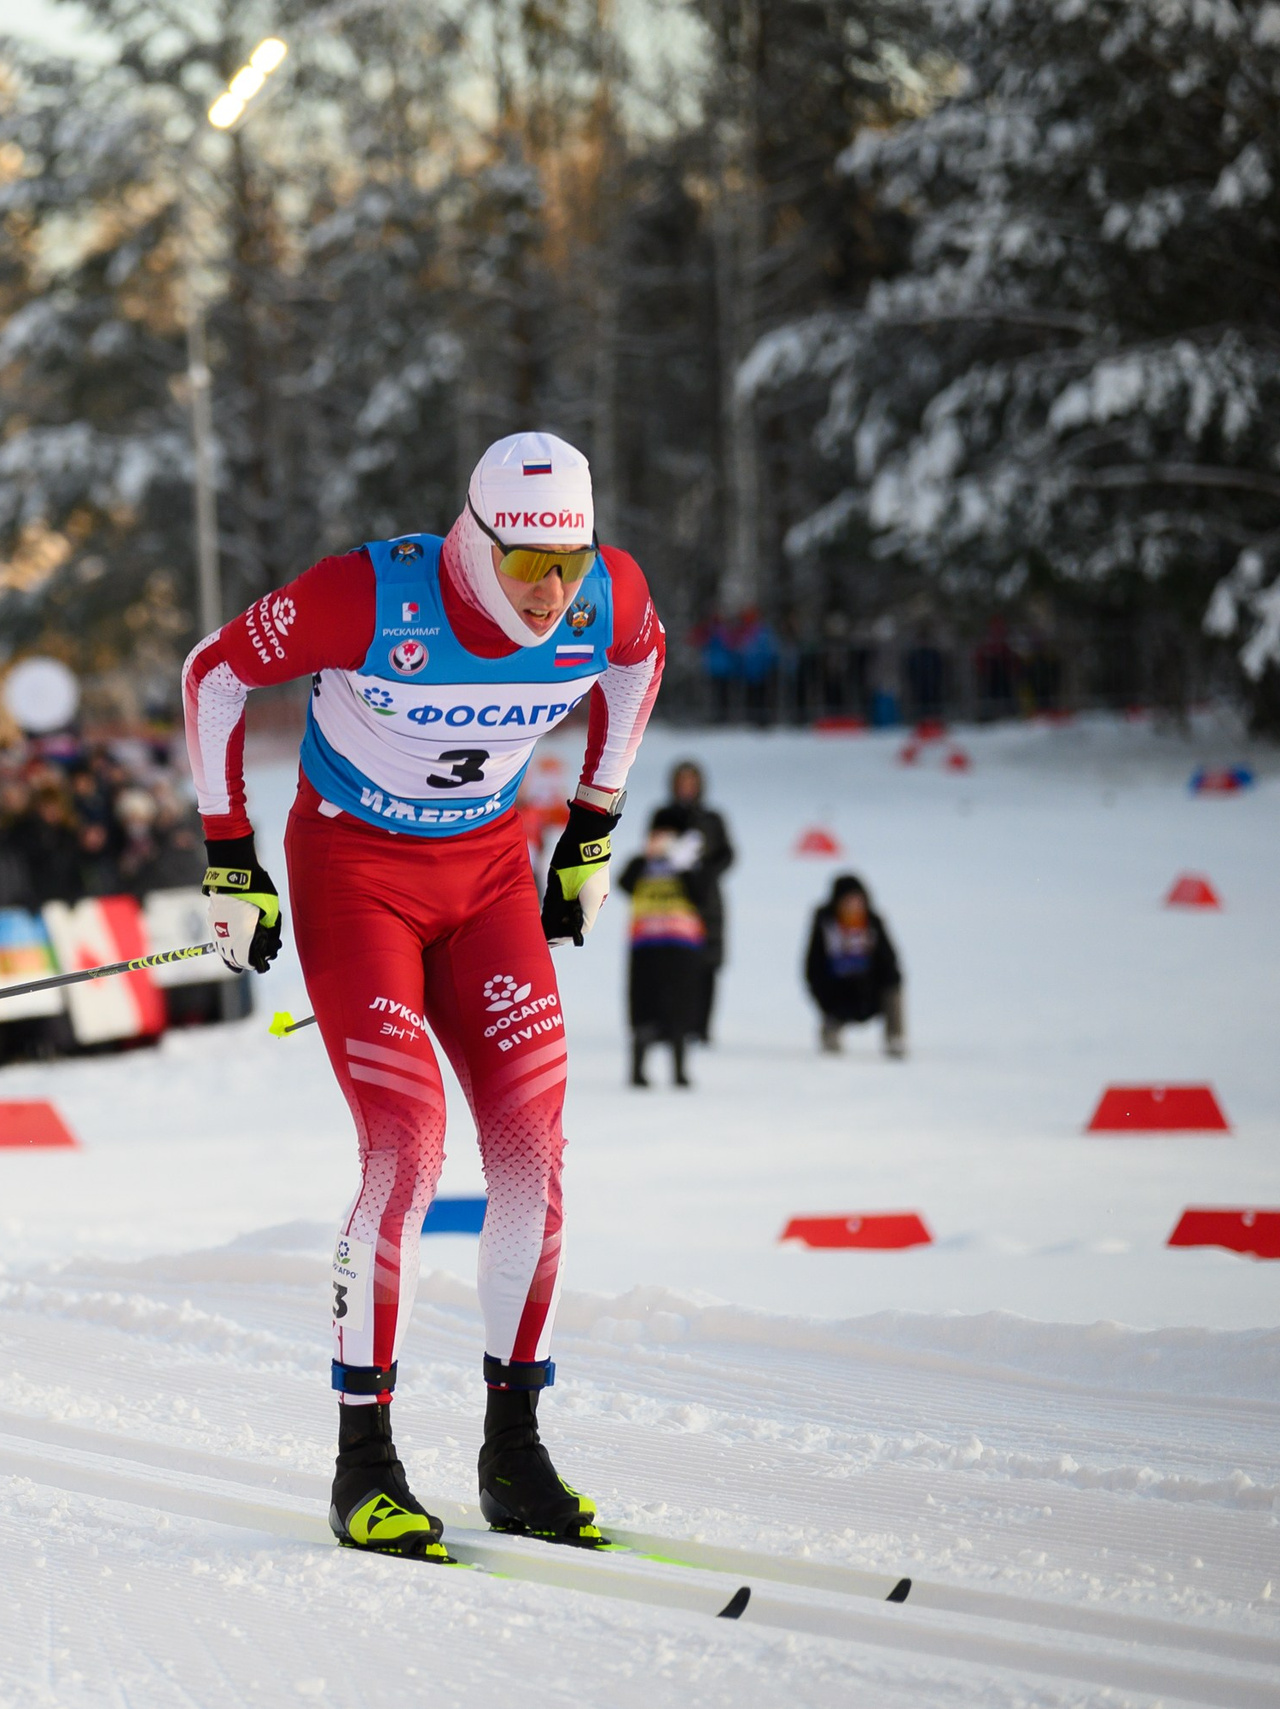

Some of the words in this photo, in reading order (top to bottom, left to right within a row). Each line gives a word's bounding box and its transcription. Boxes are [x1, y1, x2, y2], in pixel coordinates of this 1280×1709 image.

[494, 509, 584, 528] ЛУКОЙЛ
[245, 601, 272, 665] IVIUM
[382, 627, 440, 637] РУСКЛИМАТ
[426, 749, 490, 789] 3
[369, 996, 428, 1033] ЛУКО
[379, 1022, 420, 1042] ЭН+
[484, 994, 558, 1038] ФОСАГРО
[497, 1013, 564, 1052] BIVIUM
[332, 1280, 348, 1319] 3
